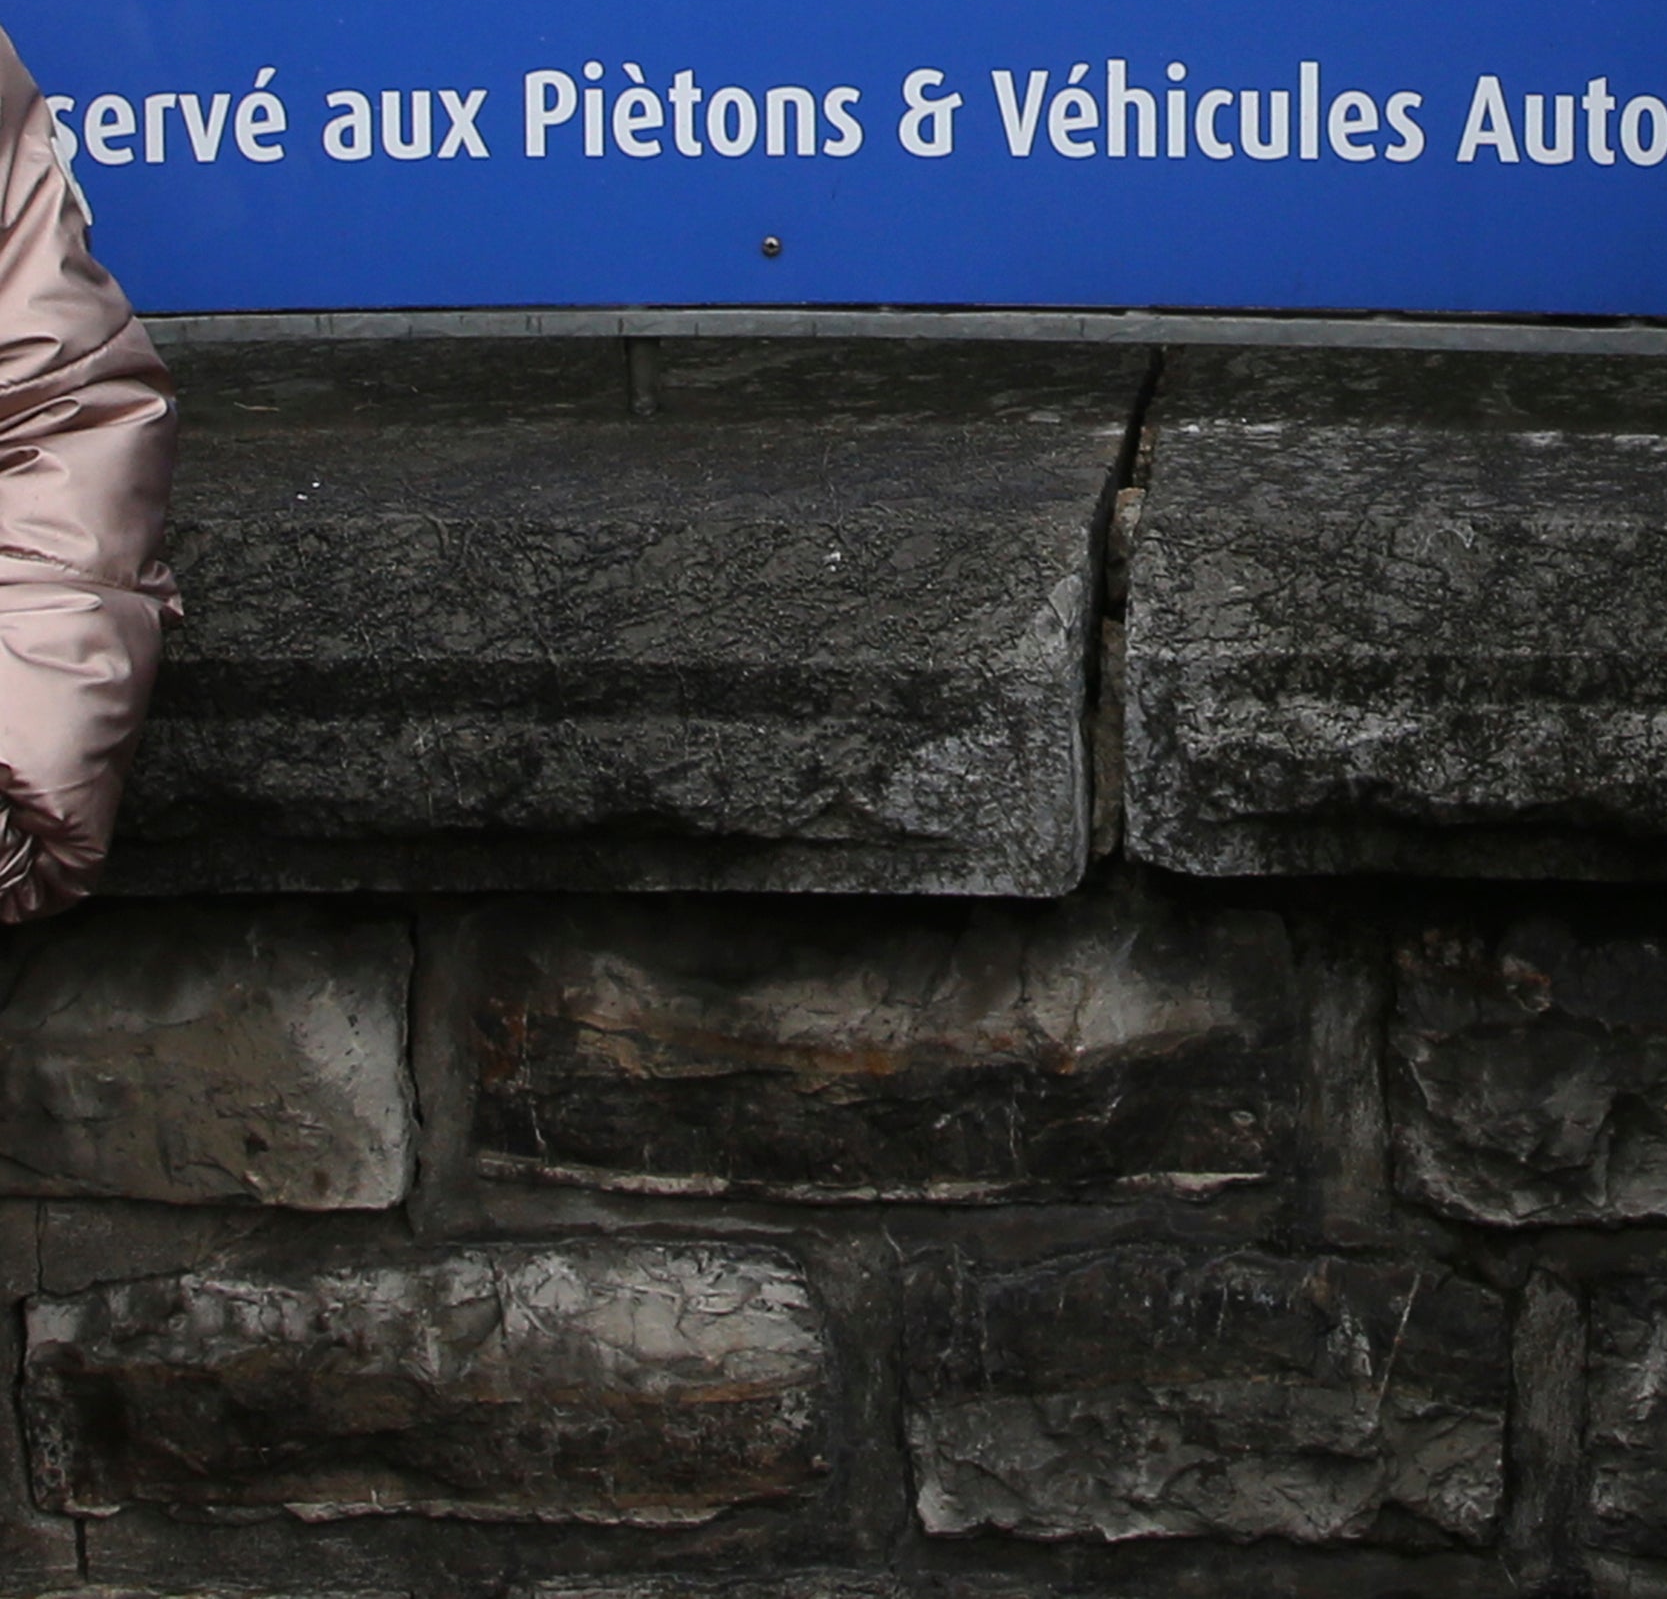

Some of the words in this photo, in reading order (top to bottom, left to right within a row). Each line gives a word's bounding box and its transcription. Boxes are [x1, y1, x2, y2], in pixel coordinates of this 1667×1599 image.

[44, 66, 287, 169] servé
[322, 89, 490, 161] aux
[524, 60, 863, 159] Piètons
[898, 68, 963, 158] &
[990, 58, 1425, 163] Véhicules
